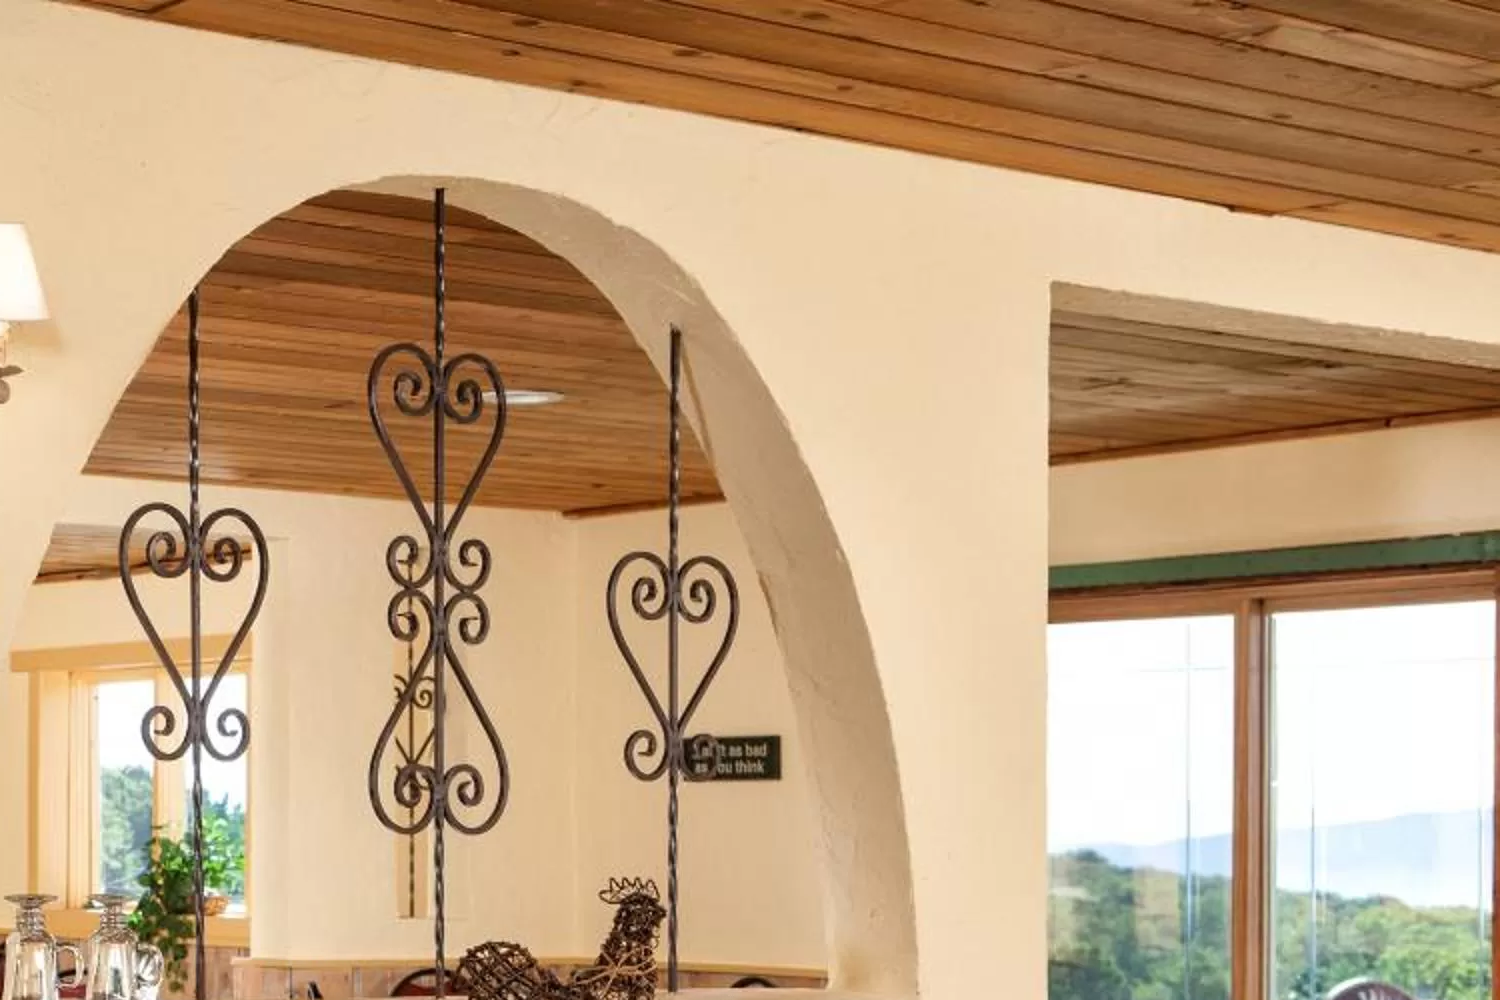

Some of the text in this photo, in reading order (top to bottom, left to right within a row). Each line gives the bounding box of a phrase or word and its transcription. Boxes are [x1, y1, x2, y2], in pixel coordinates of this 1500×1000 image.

[745, 743, 767, 757] bad
[713, 763, 733, 775] ou
[734, 760, 765, 774] think
